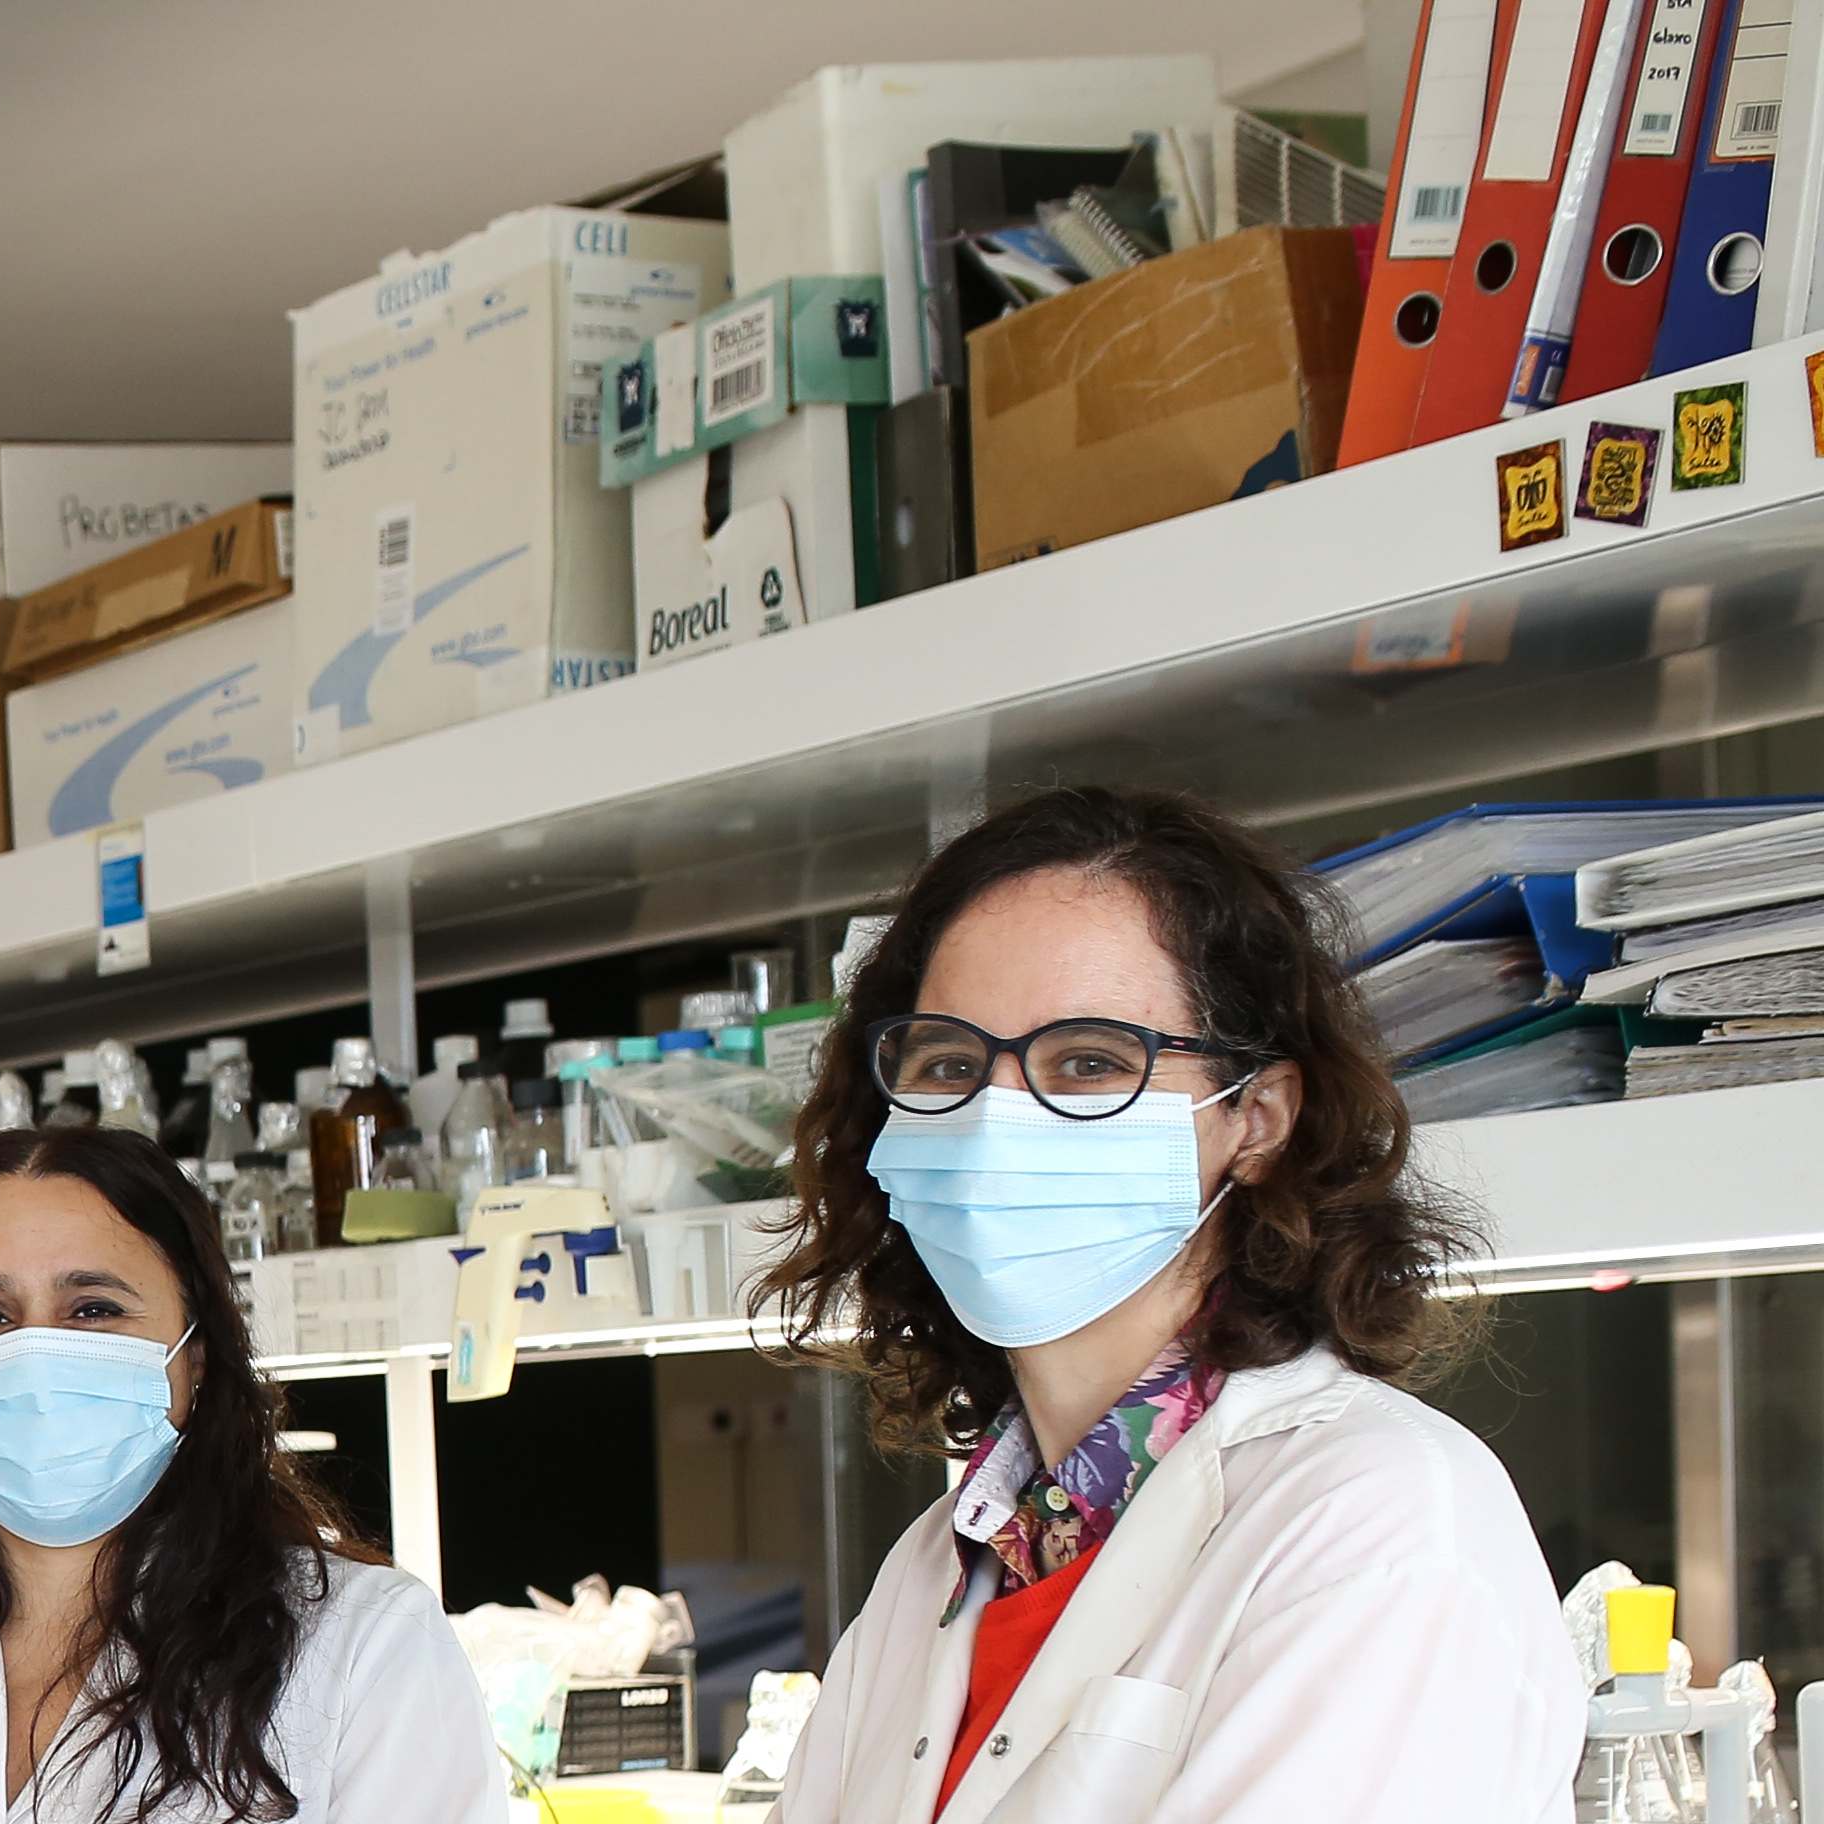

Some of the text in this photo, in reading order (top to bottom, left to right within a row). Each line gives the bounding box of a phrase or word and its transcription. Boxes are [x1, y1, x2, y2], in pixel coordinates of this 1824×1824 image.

[1647, 66, 1681, 81] 2017
[376, 261, 452, 318] CELLSTAR
[649, 583, 731, 656] Boreal
